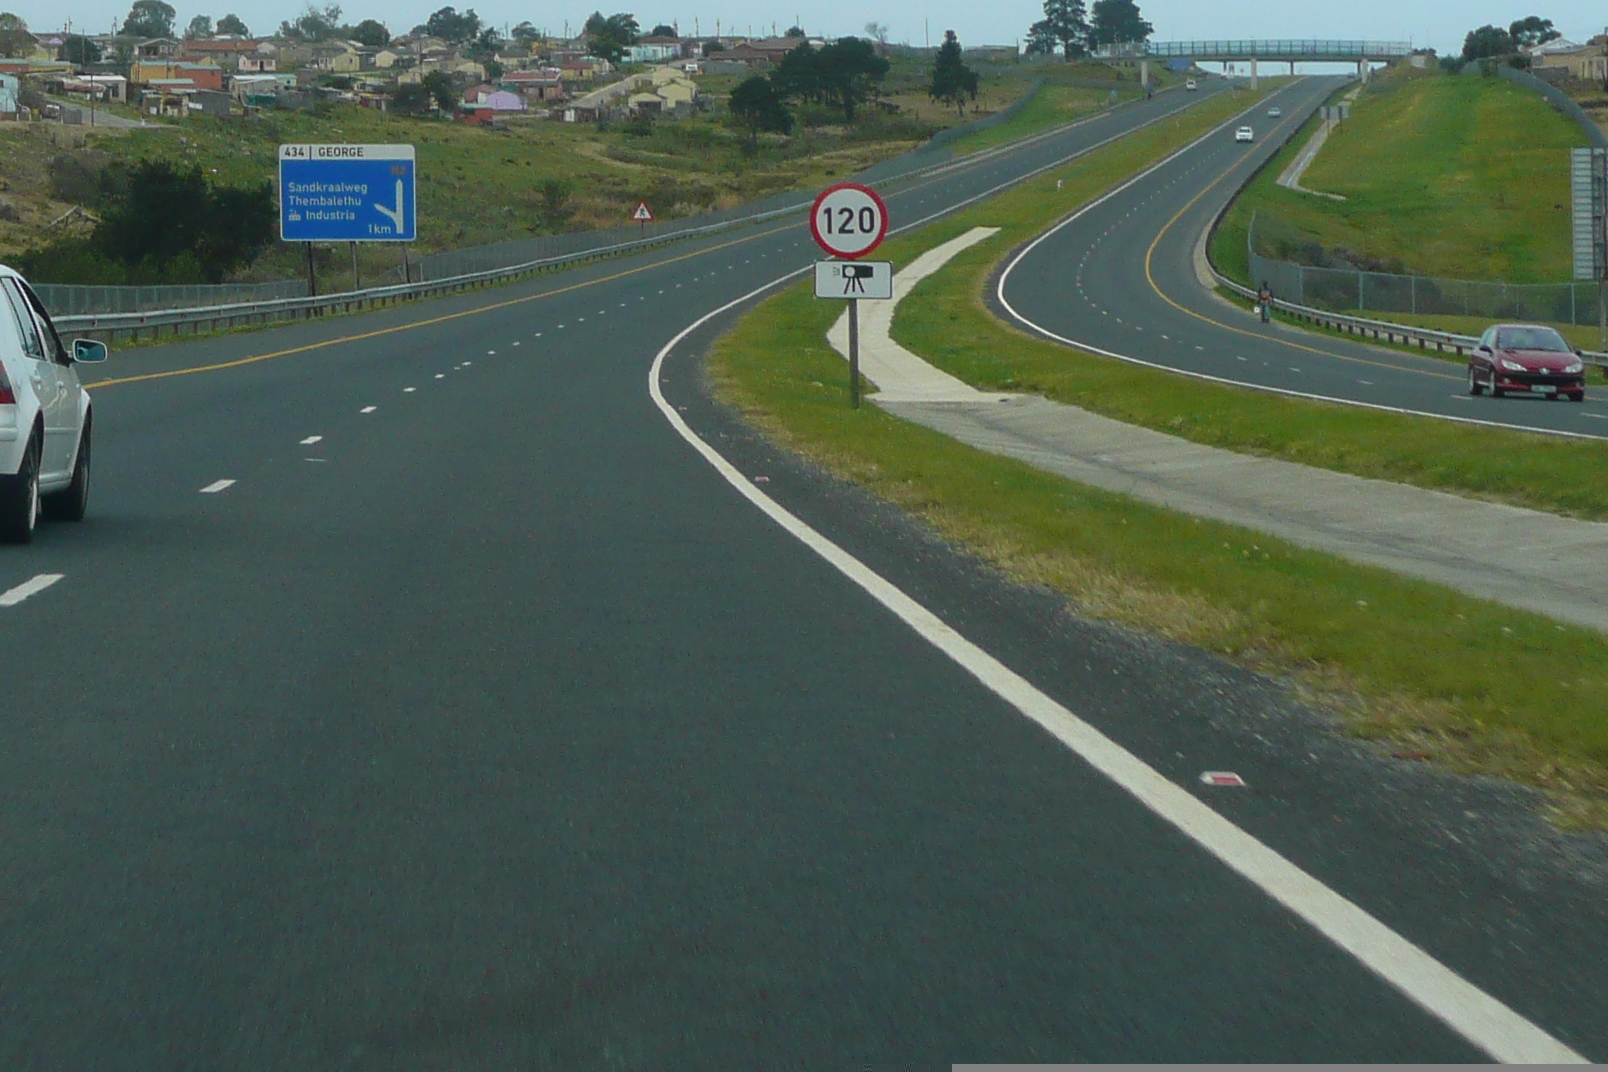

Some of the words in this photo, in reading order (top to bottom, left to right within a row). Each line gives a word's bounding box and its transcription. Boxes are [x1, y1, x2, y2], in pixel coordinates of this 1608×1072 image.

[284, 147, 305, 157] 434
[318, 147, 364, 157] GEORGE
[288, 182, 368, 194] Sandkraalweg
[288, 196, 362, 206] Thembalethu
[306, 210, 355, 220] Industria
[823, 206, 875, 234] 120
